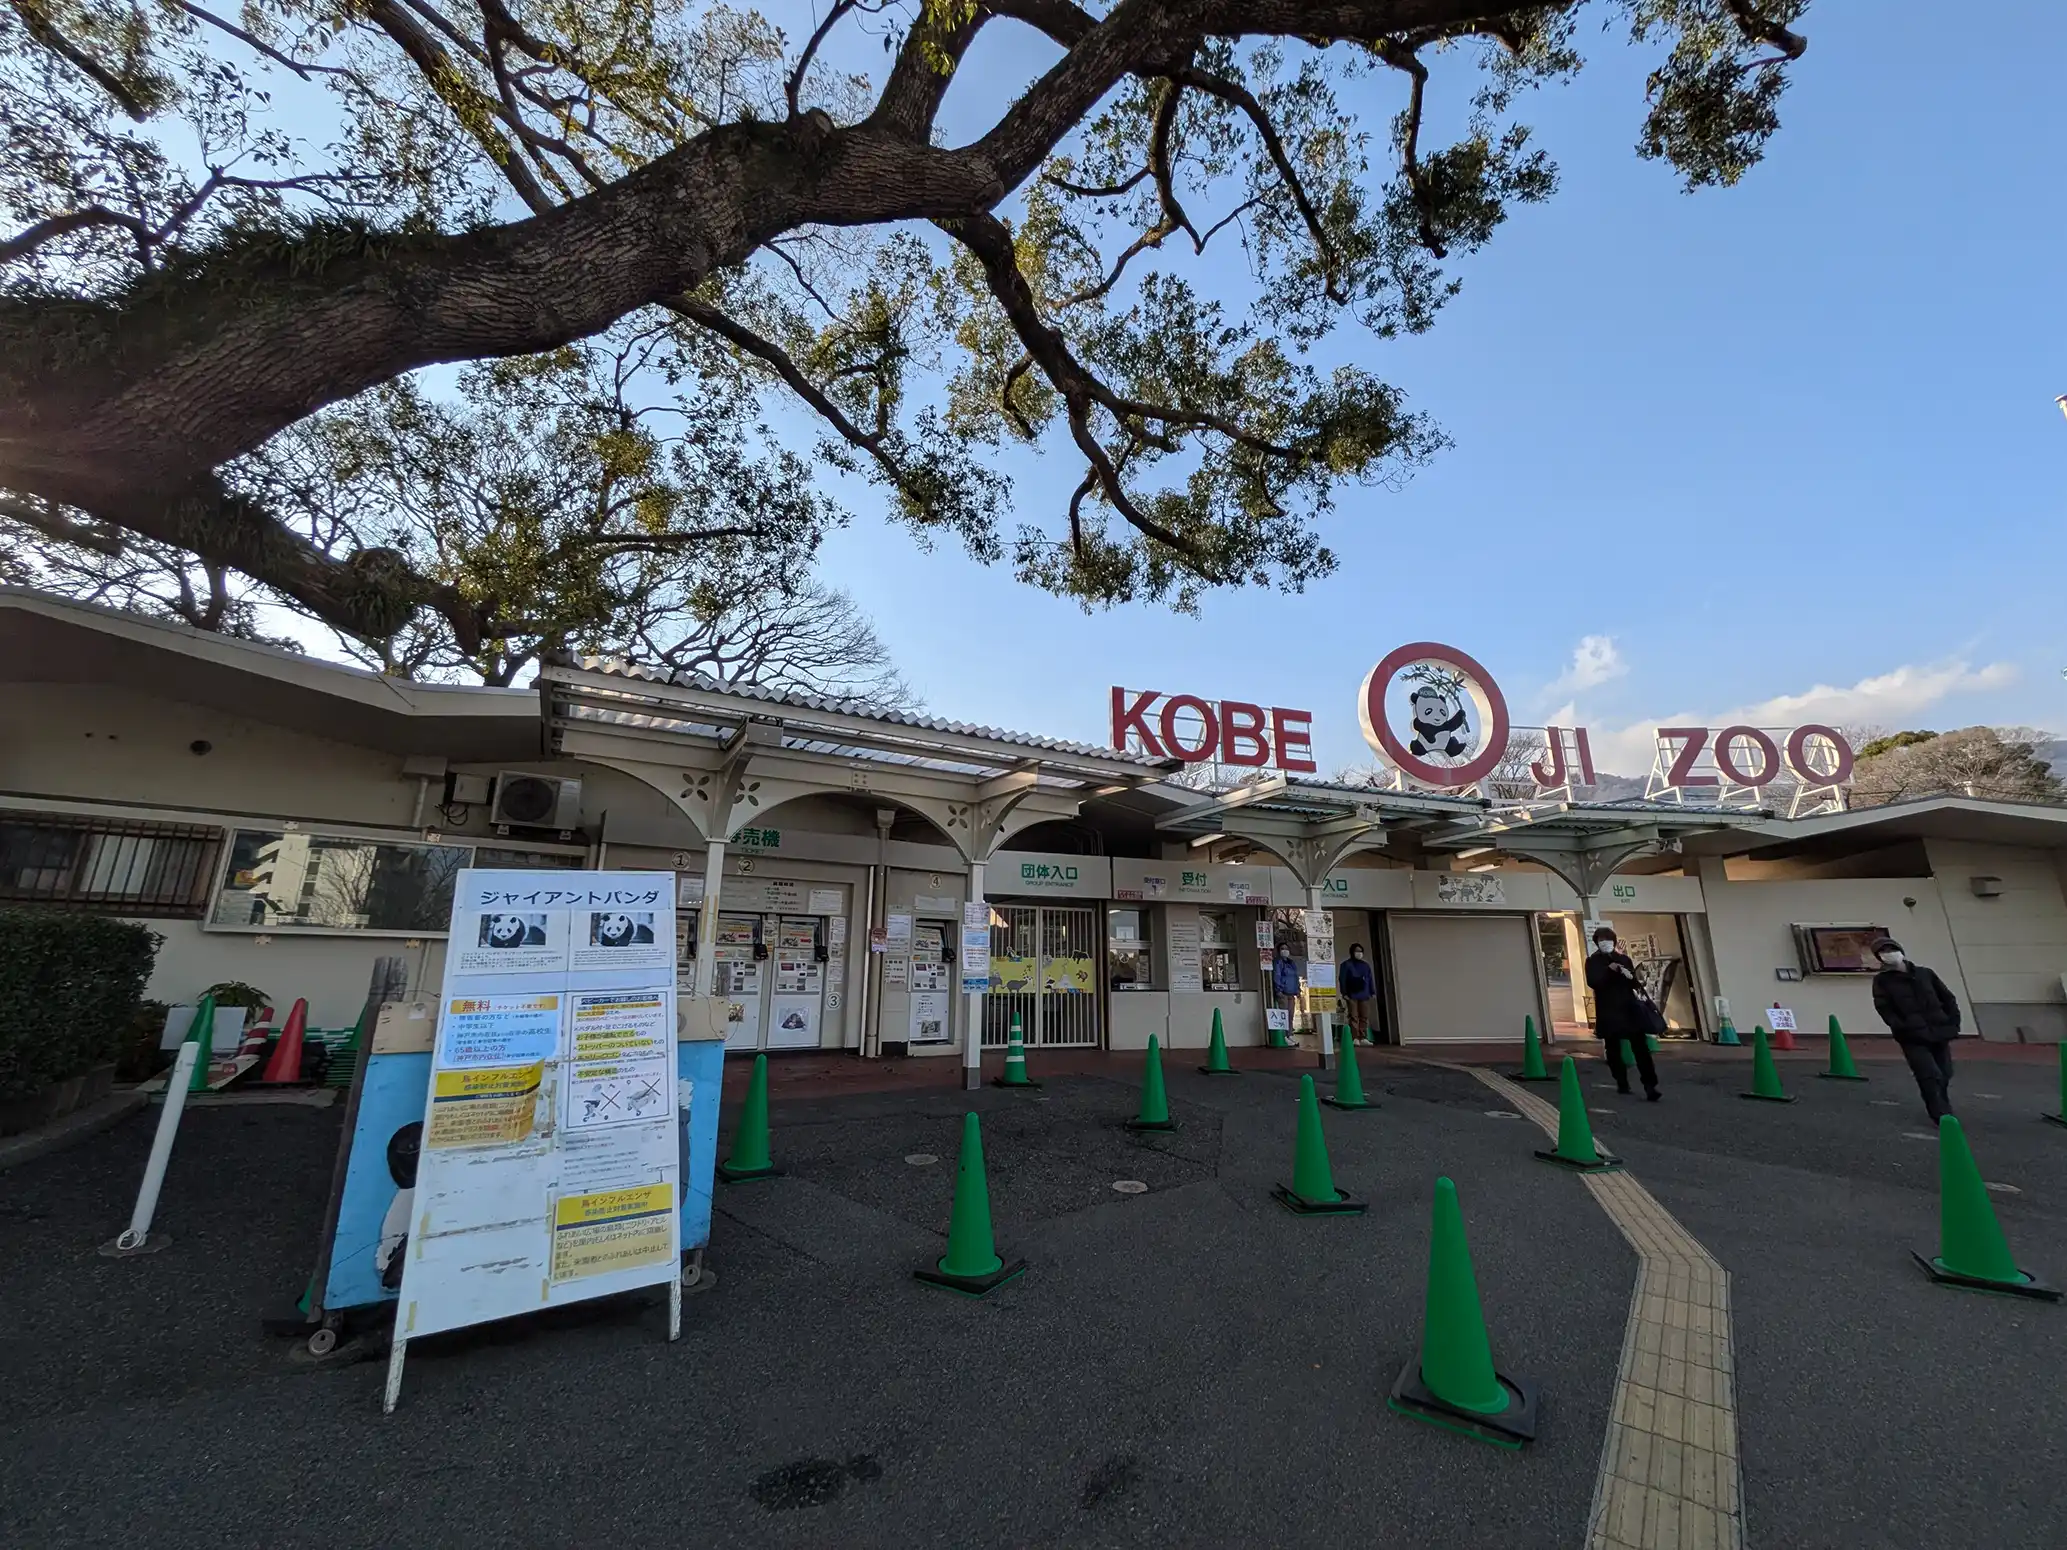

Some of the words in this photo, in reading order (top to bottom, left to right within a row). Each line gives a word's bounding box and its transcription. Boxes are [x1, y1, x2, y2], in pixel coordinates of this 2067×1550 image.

[1112, 686, 1317, 773] KOBE
[1658, 724, 1854, 786] ZOO
[1022, 864, 1077, 880] 団体入口
[1182, 872, 1207, 887] 受付
[1323, 879, 1347, 891] 入口
[1613, 885, 1636, 897] 出口
[480, 890, 660, 905] ジャイアントパンダ
[462, 1000, 491, 1012] 無料
[582, 1191, 652, 1208] 鳥インフルエンザ
